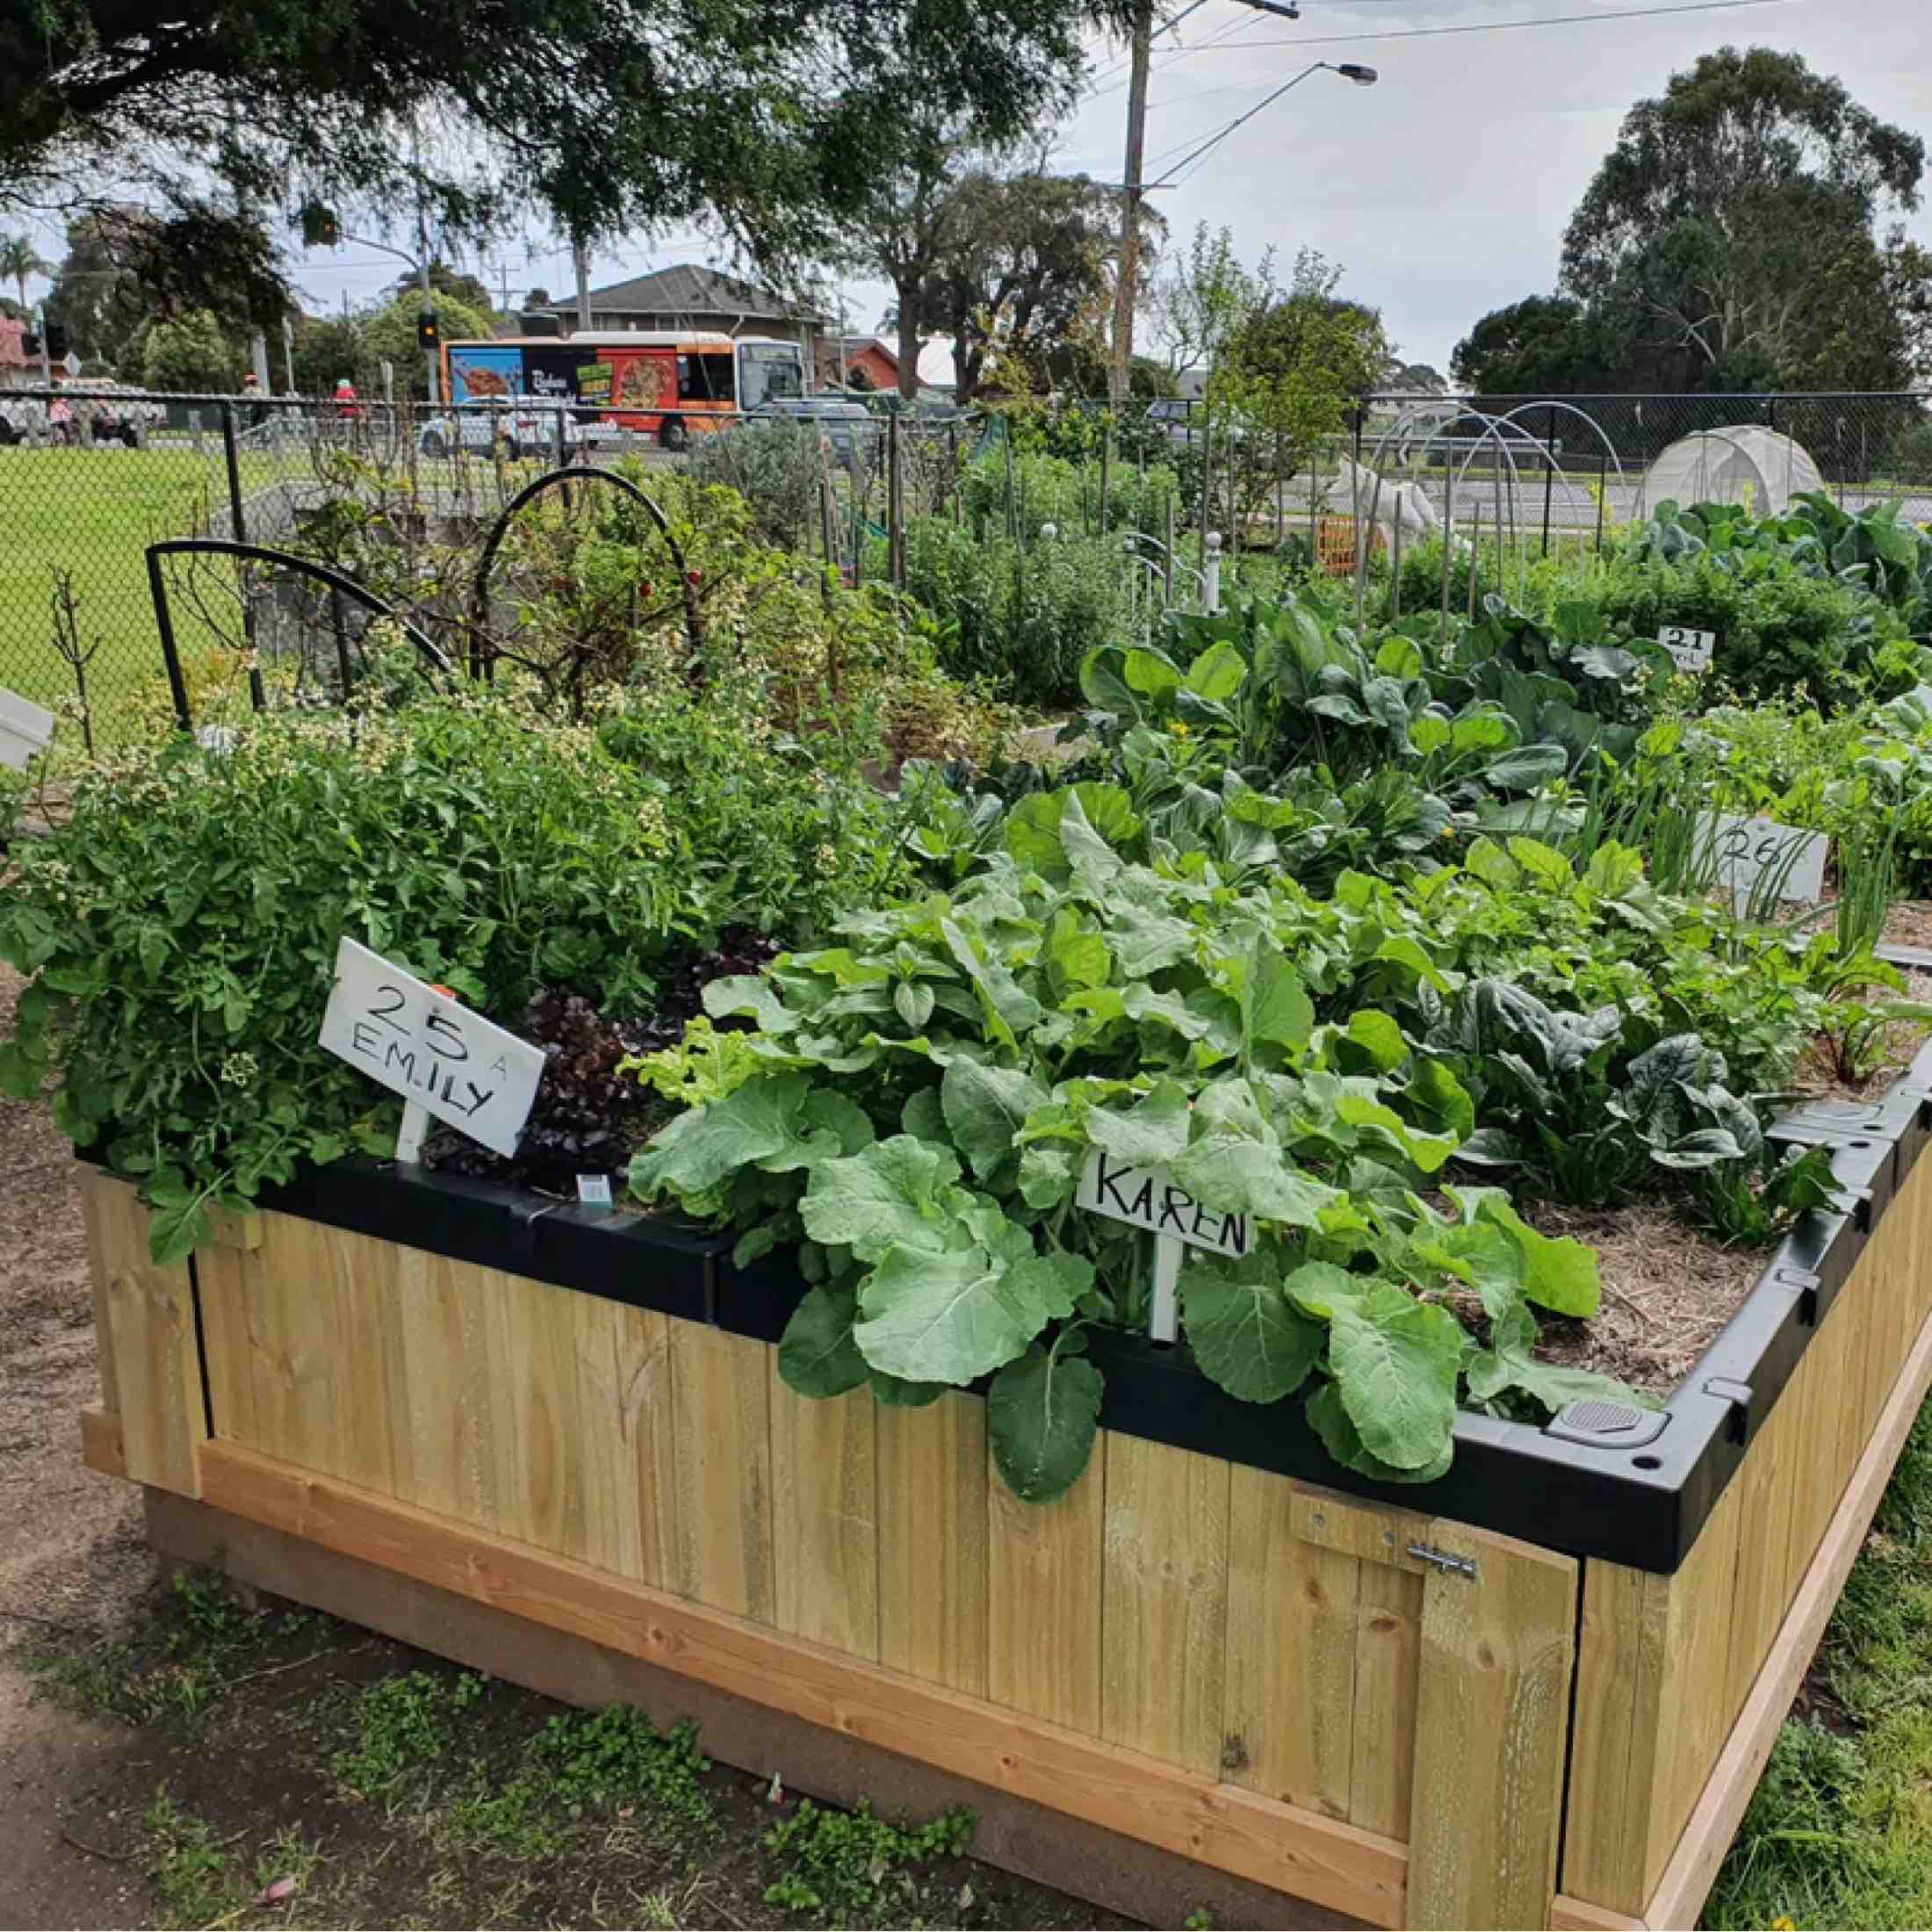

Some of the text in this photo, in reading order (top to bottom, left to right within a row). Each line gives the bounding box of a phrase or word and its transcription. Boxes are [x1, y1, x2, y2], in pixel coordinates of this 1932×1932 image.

[1668, 630, 1702, 650] 21
[365, 985, 468, 1062] 25
[353, 1021, 494, 1117] EMILY
[1096, 1152, 1246, 1253] KAREN
